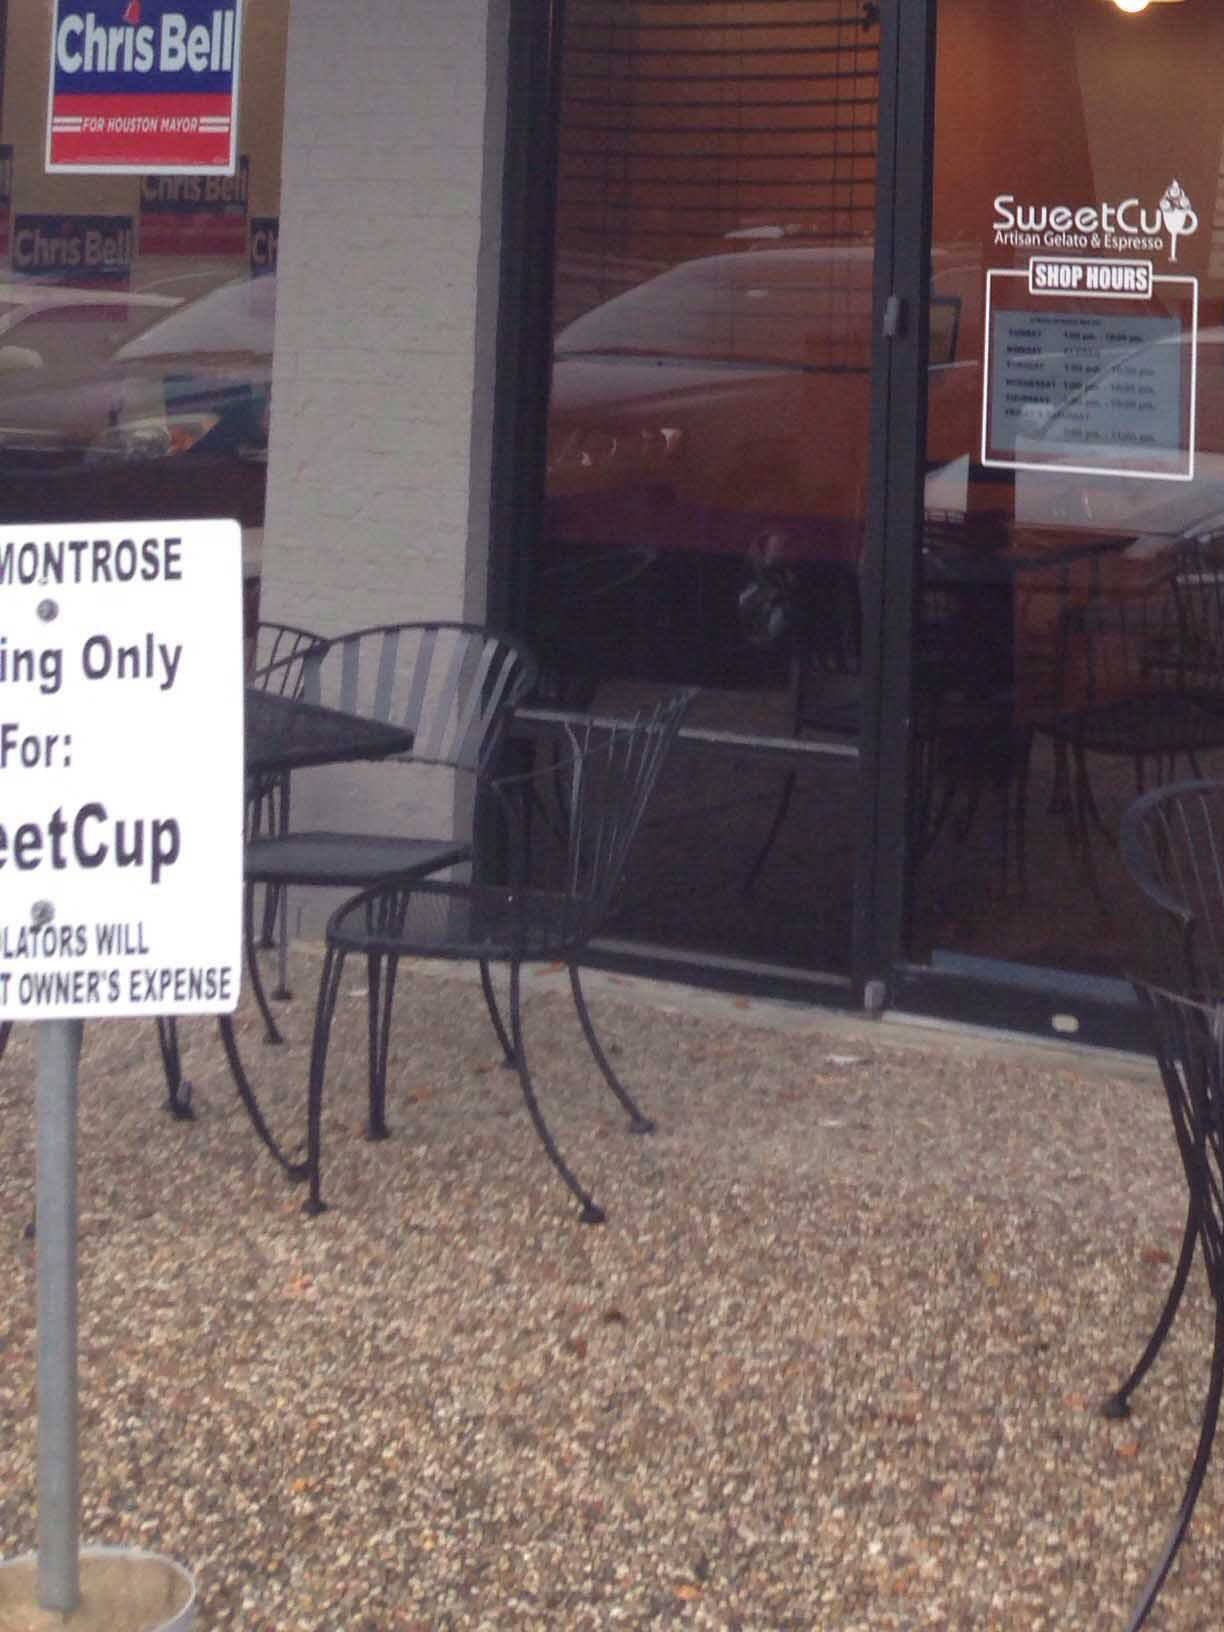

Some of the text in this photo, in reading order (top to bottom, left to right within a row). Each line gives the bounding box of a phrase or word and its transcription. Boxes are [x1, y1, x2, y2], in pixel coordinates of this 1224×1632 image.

[56, 10, 234, 73] Chris Bell
[82, 117, 198, 133] FOR HOUSTON MAYOR
[14, 229, 131, 267] Chris Bell
[994, 229, 1041, 246] Artisan
[1043, 231, 1088, 248] Gelato
[1104, 234, 1164, 252] Espresso
[1035, 264, 1148, 291] SHOP HOURS
[82, 633, 182, 691] Only
[0, 723, 72, 768] For:
[0, 802, 181, 884] etCup
[0, 922, 149, 959] LATORS WILL
[19, 969, 120, 1006] OWNER'S
[129, 966, 232, 1002] EXPENSE
